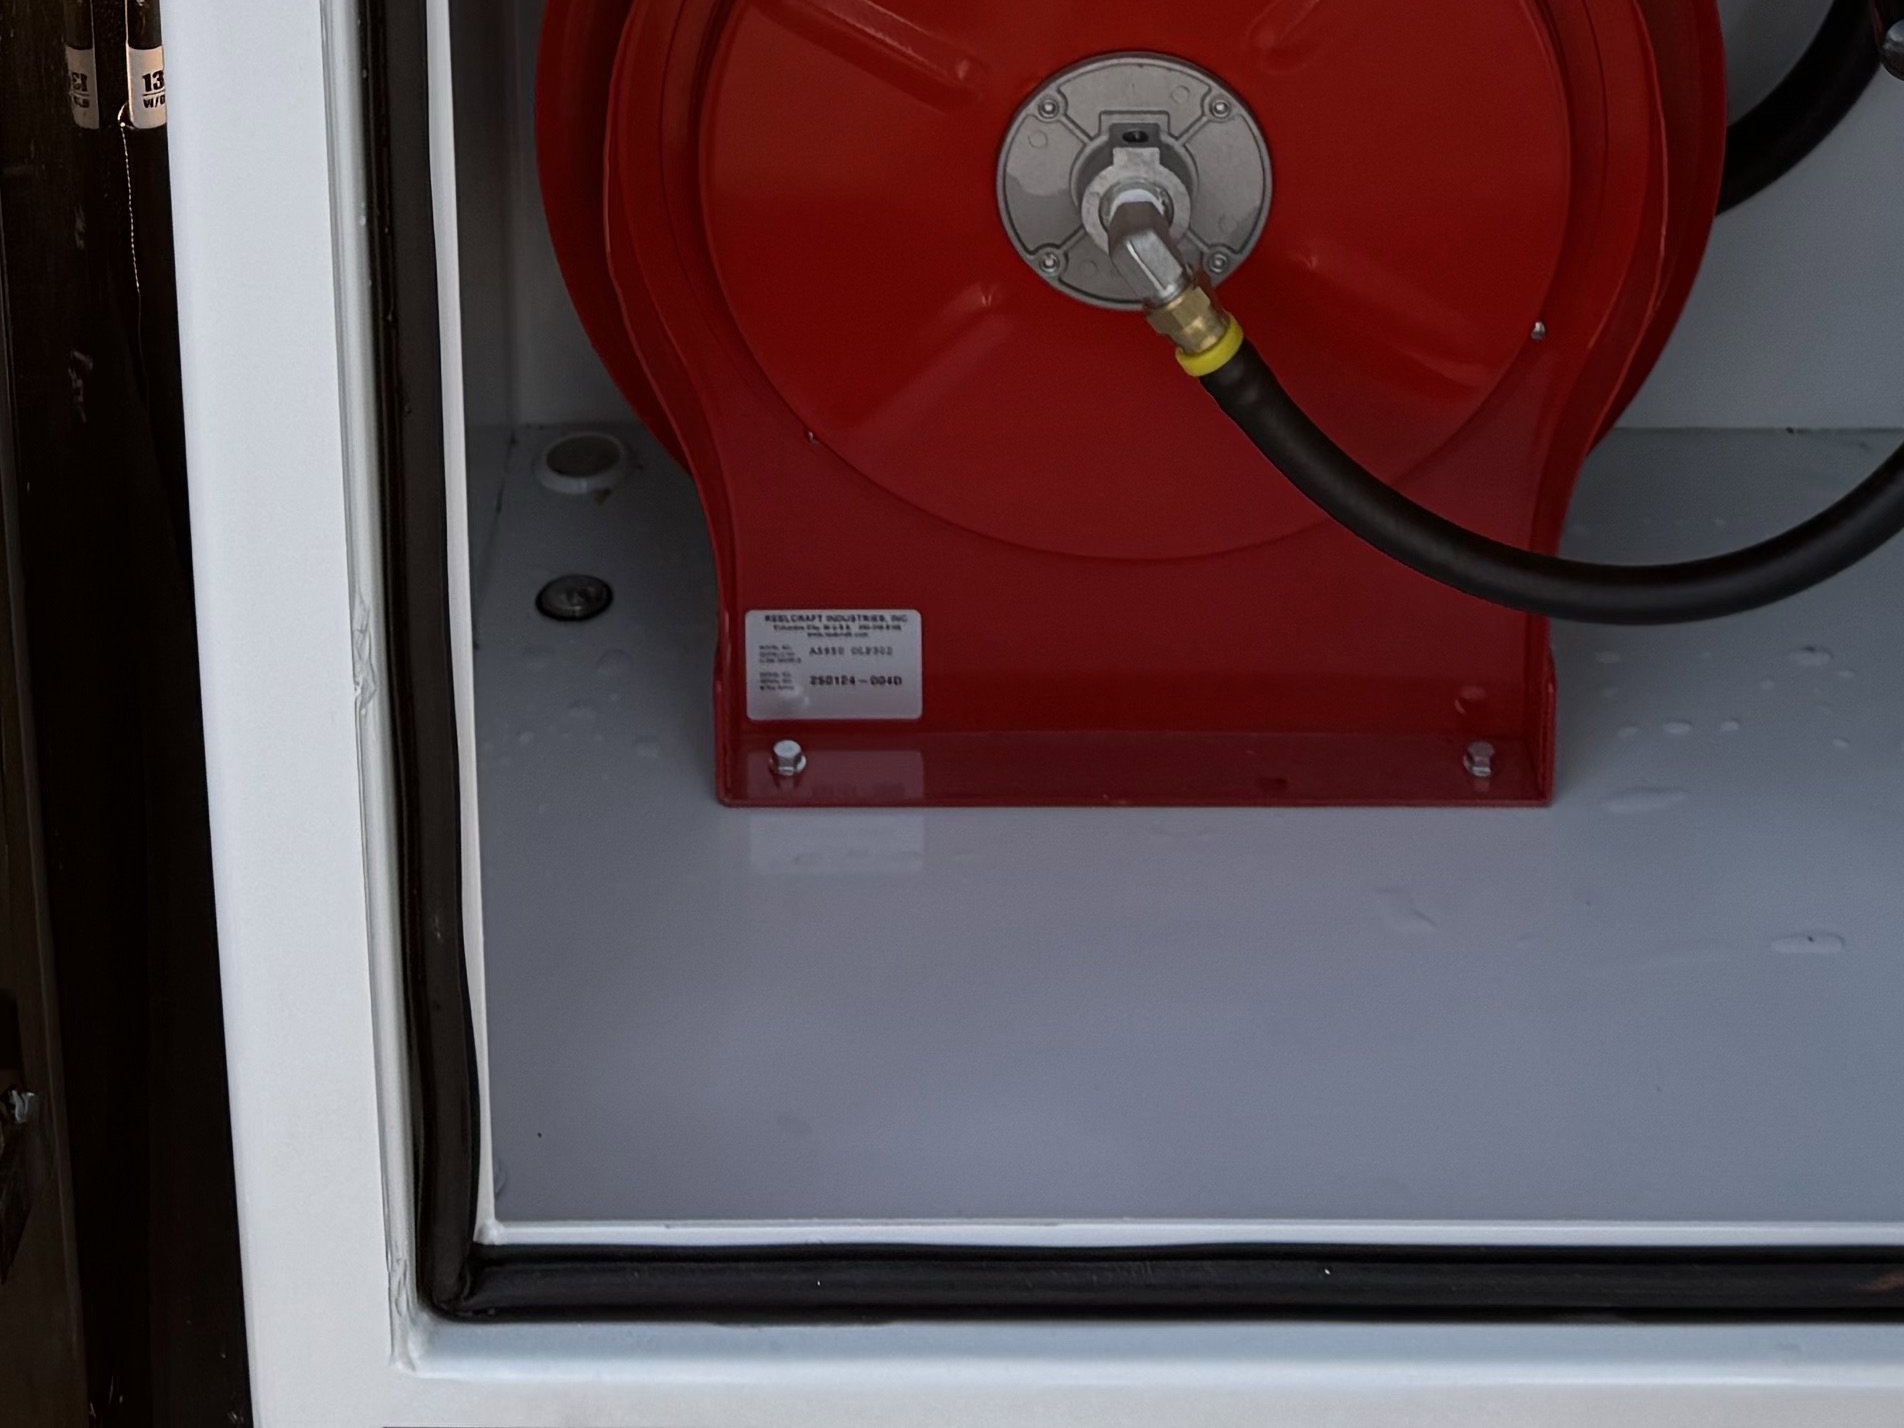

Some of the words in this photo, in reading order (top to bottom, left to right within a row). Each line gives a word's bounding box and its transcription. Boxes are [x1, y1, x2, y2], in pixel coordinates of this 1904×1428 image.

[142, 70, 164, 92] 13
[765, 614, 822, 622] REELCRAFT
[826, 614, 887, 623] INDUSTRIES,
